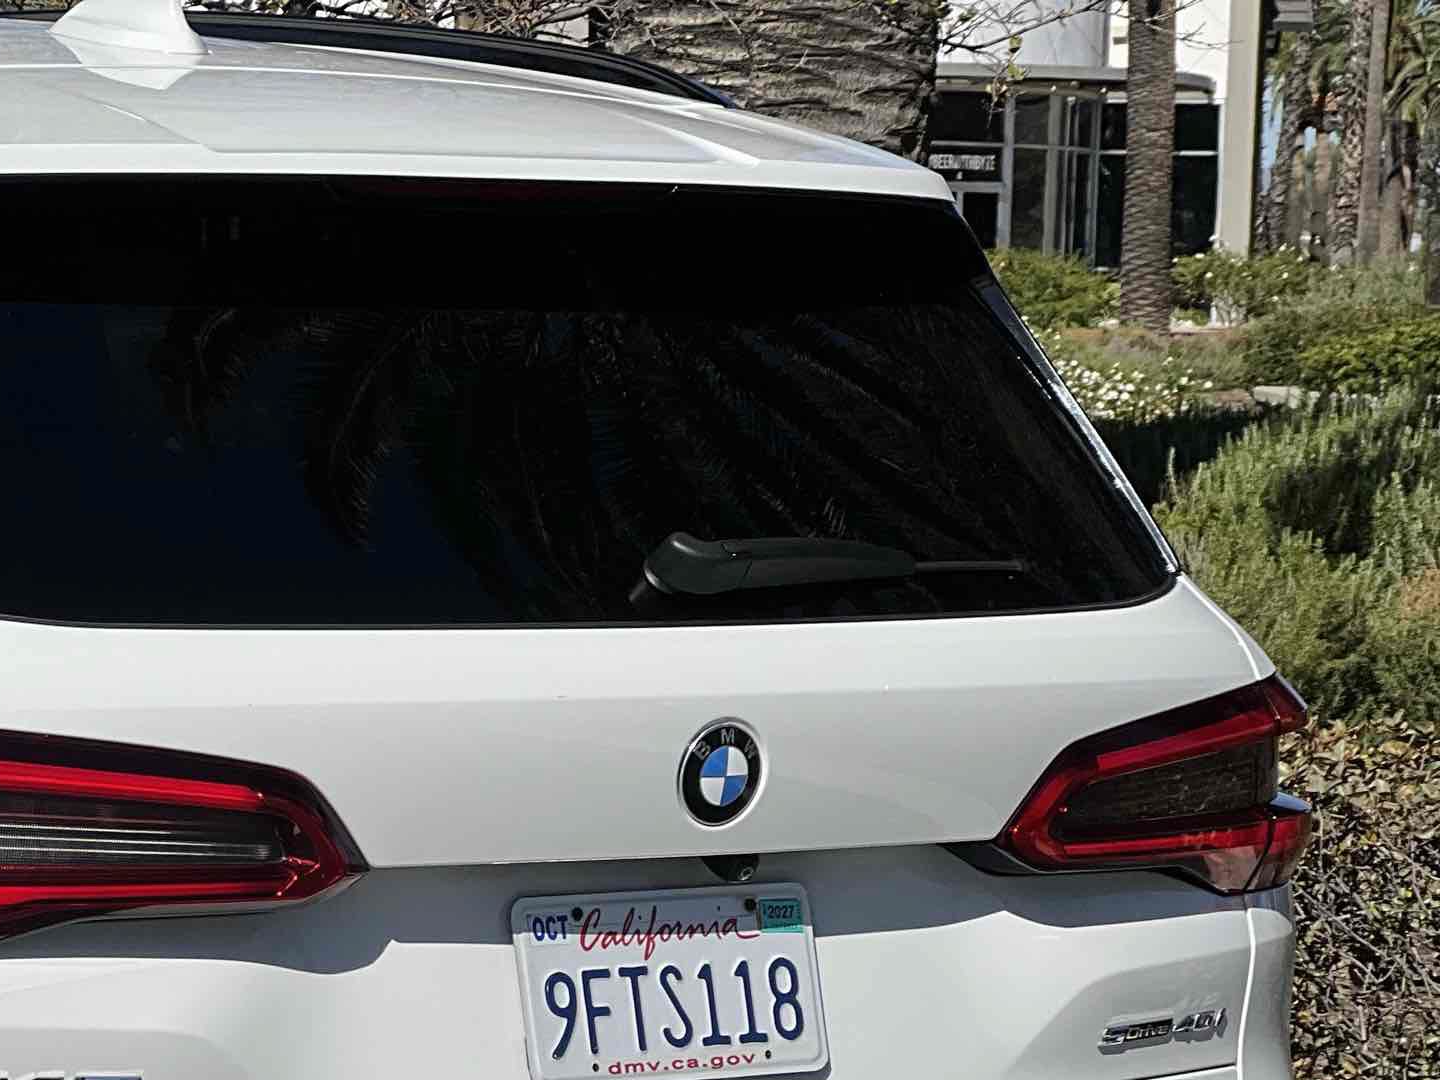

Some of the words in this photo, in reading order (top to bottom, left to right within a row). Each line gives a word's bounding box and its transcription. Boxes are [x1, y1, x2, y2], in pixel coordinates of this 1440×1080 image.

[693, 727, 757, 760] BMW
[767, 904, 795, 919] 2027
[531, 915, 568, 942] OCT
[580, 906, 759, 960] California
[544, 957, 804, 1059] 9FTS118
[607, 1052, 756, 1075] dmv.ca.gov
